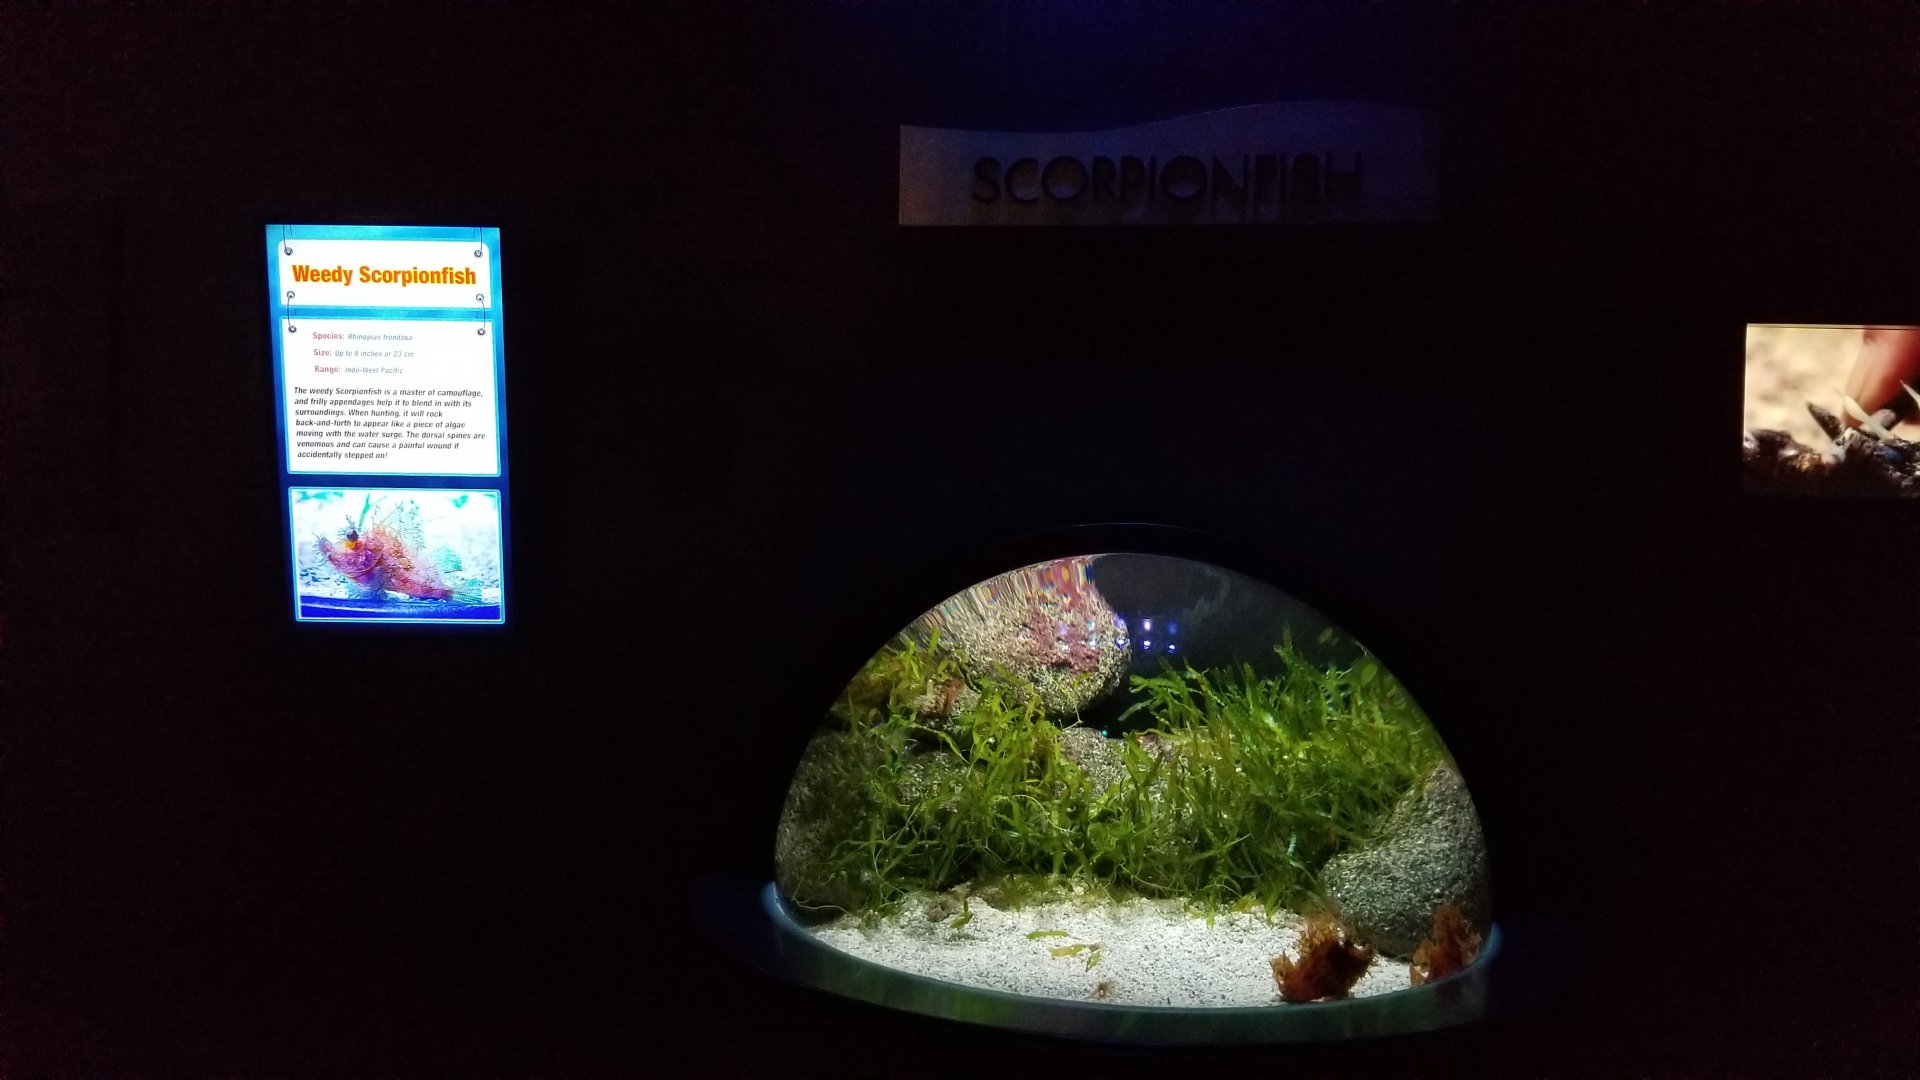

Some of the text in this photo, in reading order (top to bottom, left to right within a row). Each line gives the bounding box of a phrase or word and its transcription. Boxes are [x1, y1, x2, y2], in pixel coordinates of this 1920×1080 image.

[973, 152, 1361, 204] SCORPIONFISH
[292, 265, 477, 287] Weedy Scorpionfish
[312, 332, 345, 340] Species:
[313, 349, 332, 357] Size:
[335, 350, 344, 358] Up
[314, 366, 341, 374] Range:
[294, 387, 307, 395] The
[309, 388, 333, 396] weedy
[335, 387, 382, 396] Scorpionfish
[399, 388, 426, 396] master
[437, 389, 483, 398] camouflage,
[310, 398, 327, 406] frilly
[329, 398, 374, 407] appendages
[376, 399, 393, 407] help
[411, 399, 432, 407] blend
[295, 409, 346, 417] surroundings.
[348, 409, 369, 417] When
[296, 419, 351, 427] back-and-forth
[391, 420, 404, 428] like
[413, 421, 433, 429] piece
[445, 421, 466, 429] algae
[296, 430, 323, 438] moving
[447, 432, 471, 440] spines
[398, 442, 425, 450] painful
[297, 451, 342, 459] accidentally
[344, 451, 373, 460] stepped
